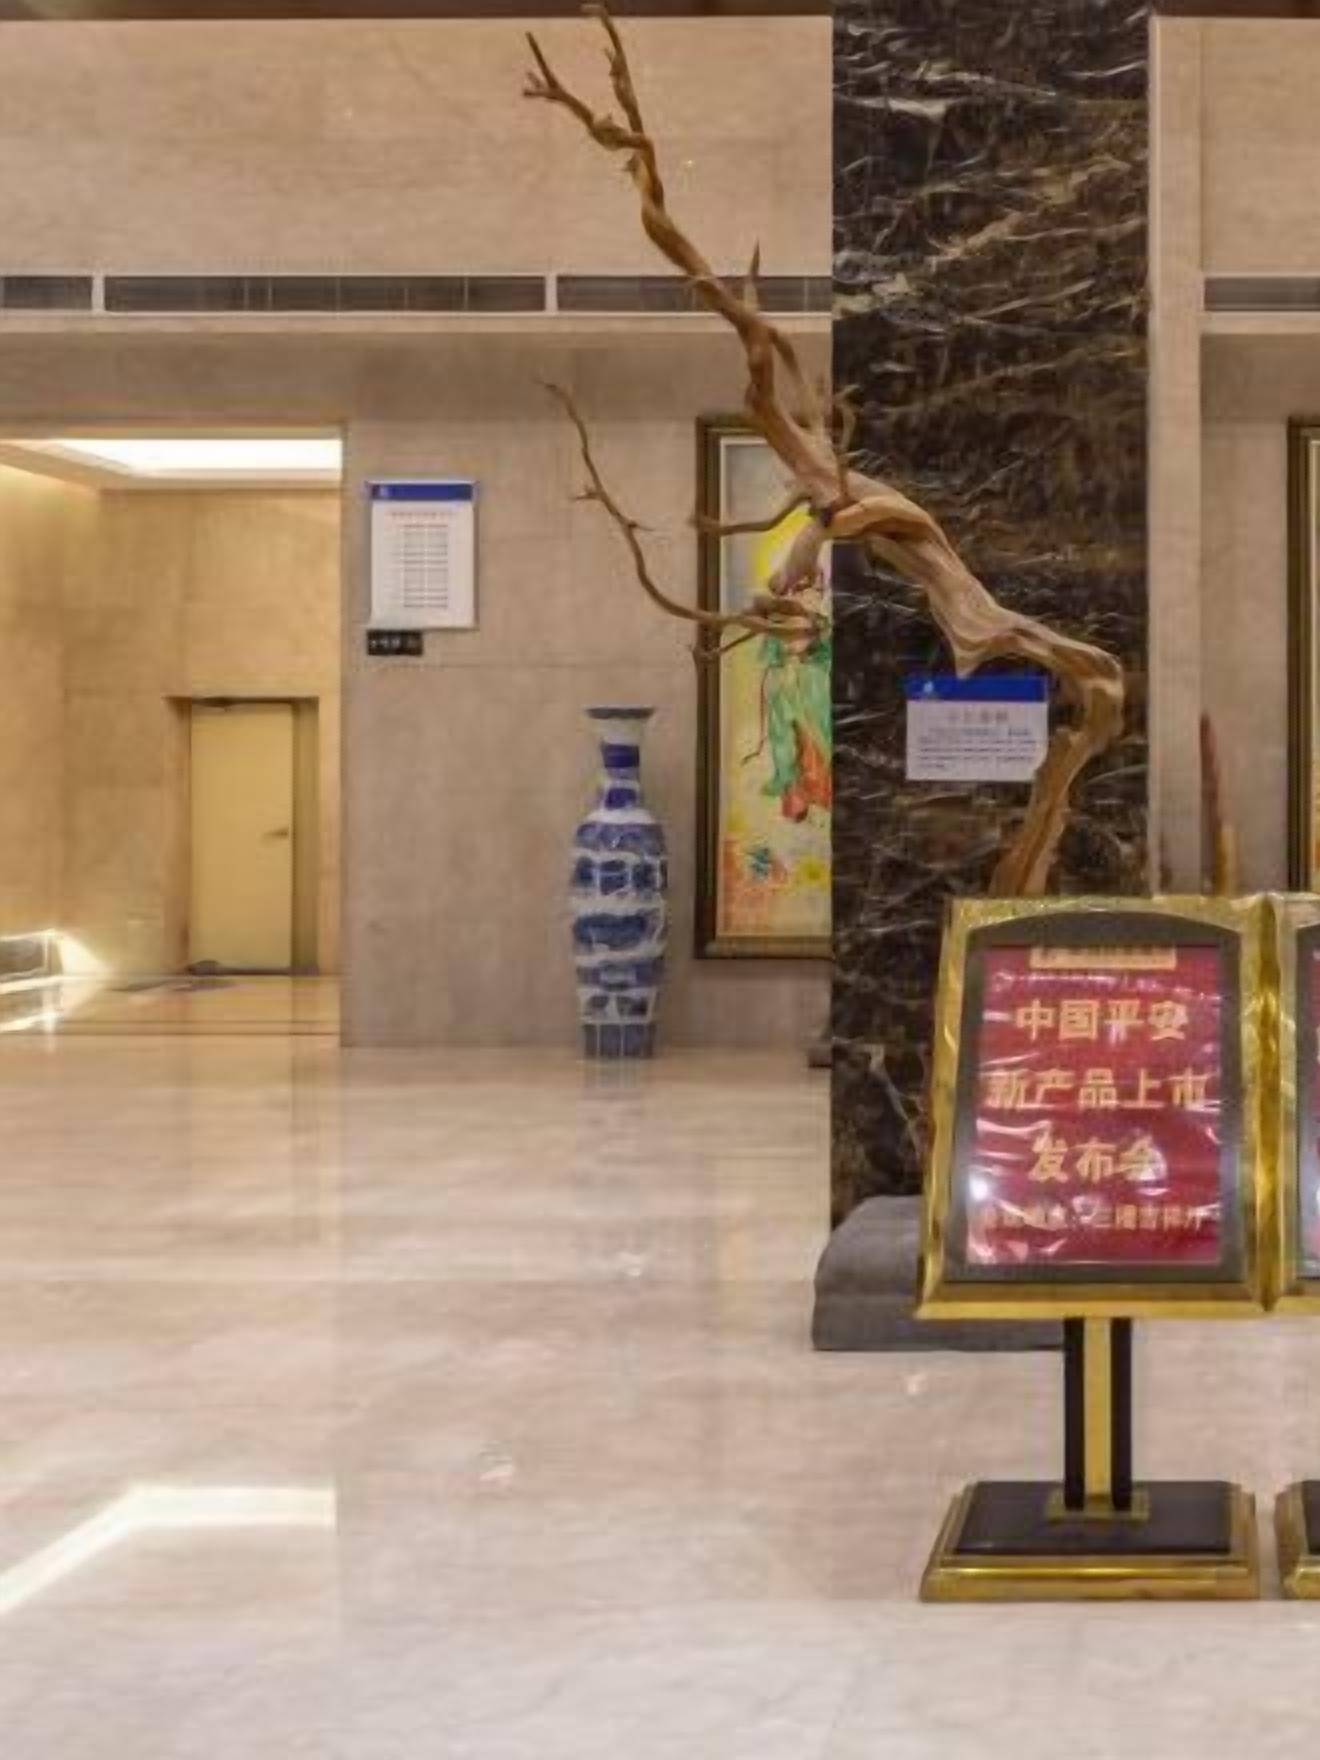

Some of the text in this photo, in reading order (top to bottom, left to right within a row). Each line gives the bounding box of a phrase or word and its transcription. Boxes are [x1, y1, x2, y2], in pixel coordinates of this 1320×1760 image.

[1016, 999, 1189, 1041] 中国平安
[985, 1067, 1212, 1110] 新产品上市
[1028, 1133, 1167, 1184] 发布会
